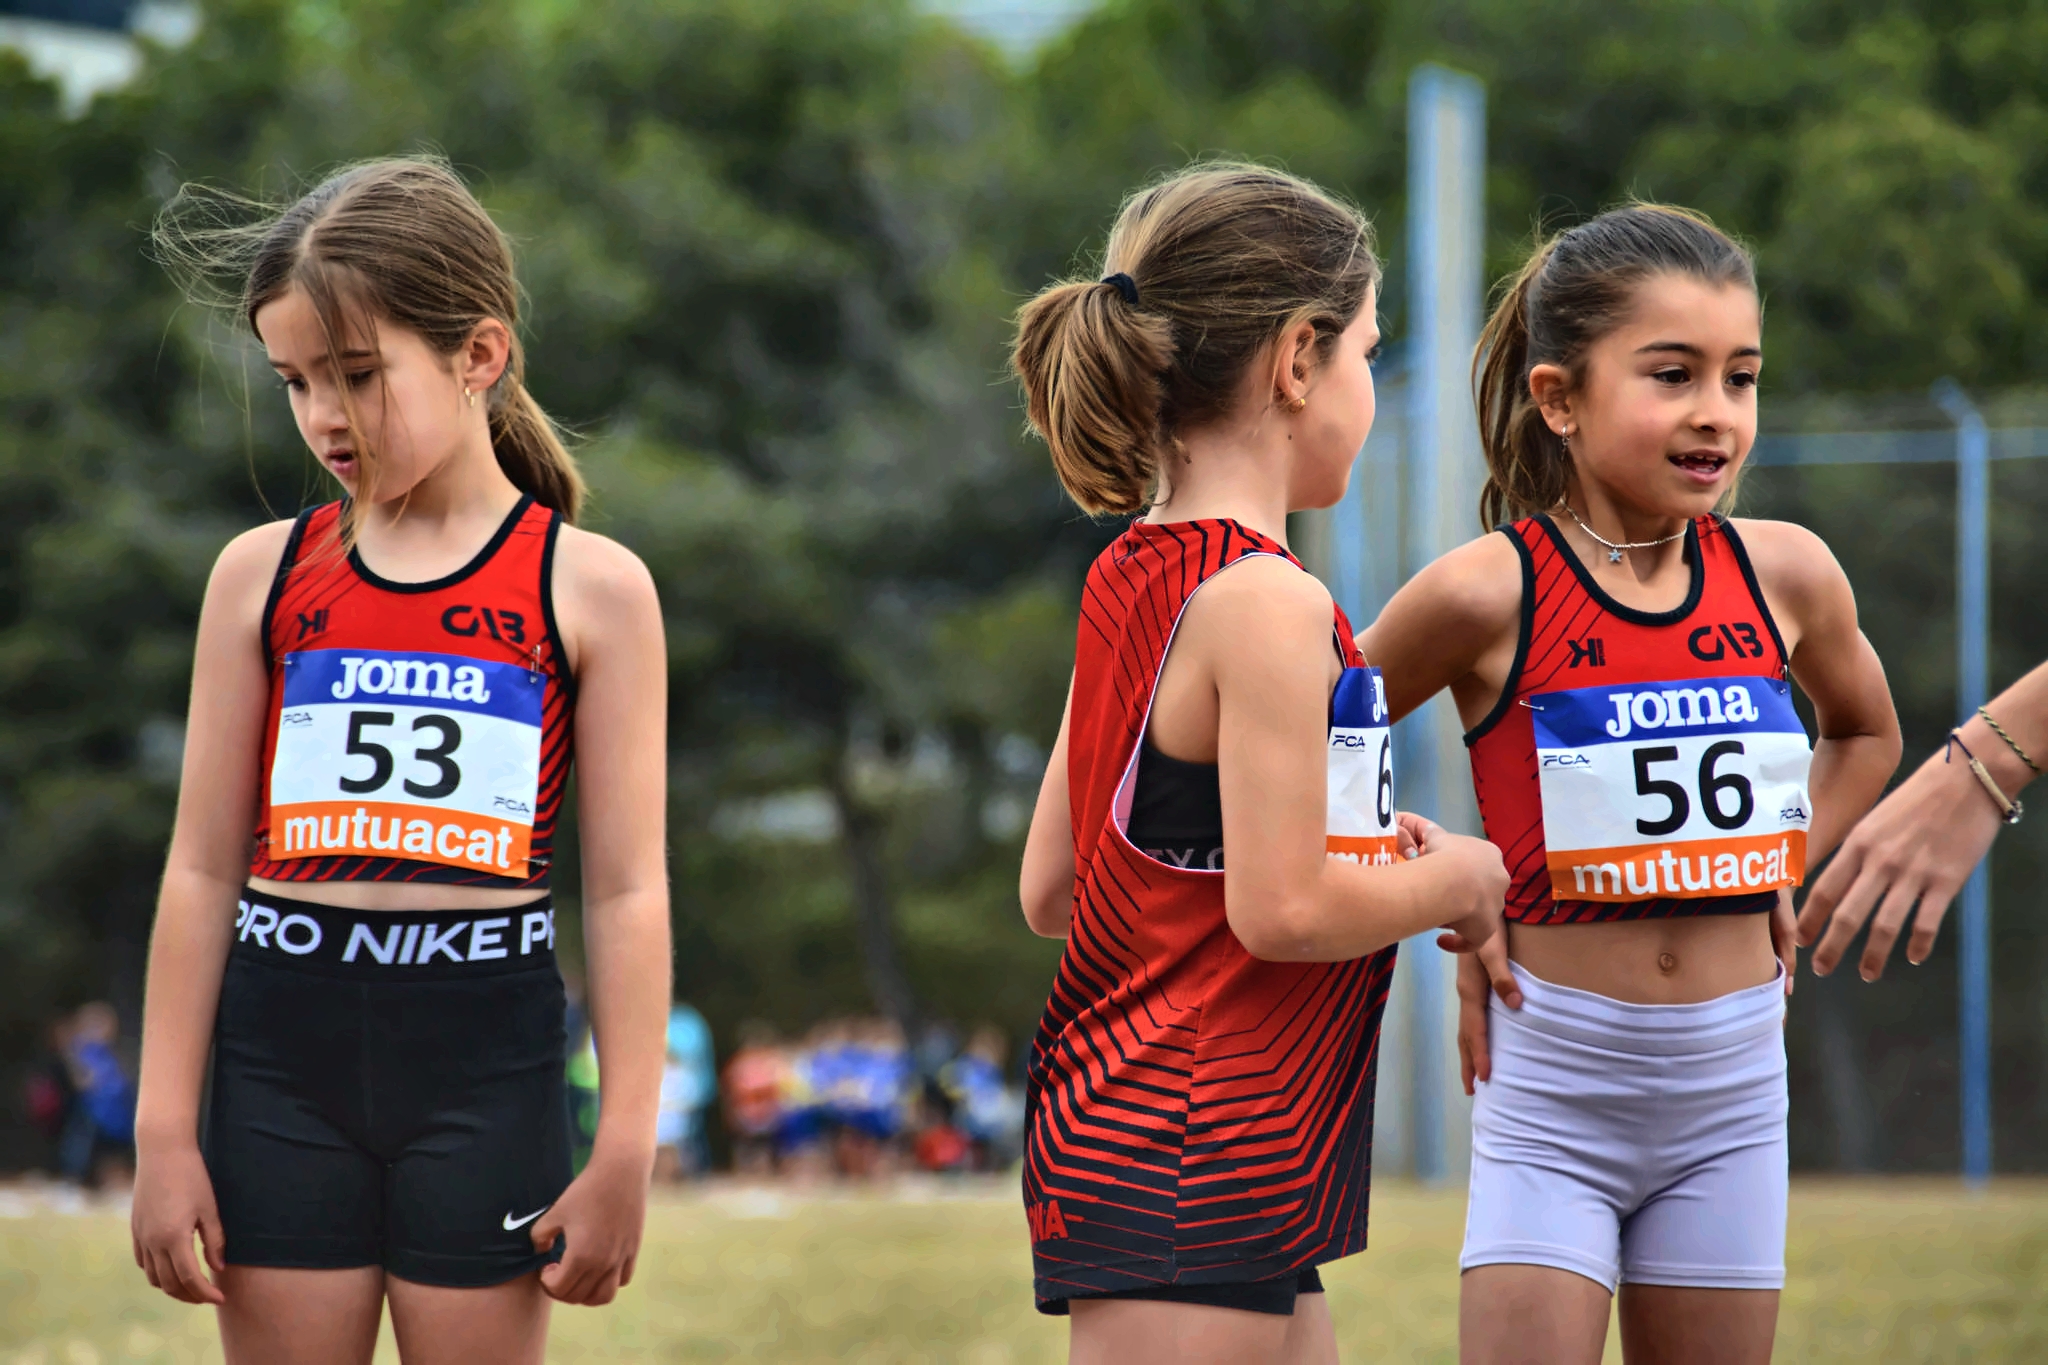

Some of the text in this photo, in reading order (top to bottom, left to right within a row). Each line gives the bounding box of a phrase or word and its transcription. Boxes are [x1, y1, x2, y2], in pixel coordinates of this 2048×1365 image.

[339, 711, 462, 800] 53
[1332, 735, 1366, 747] FCA
[1543, 754, 1591, 766] FCA
[1632, 740, 1754, 836] 56
[284, 807, 513, 869] mutuacat
[1572, 839, 1789, 896] mutuacat
[341, 917, 511, 965] NIKE
